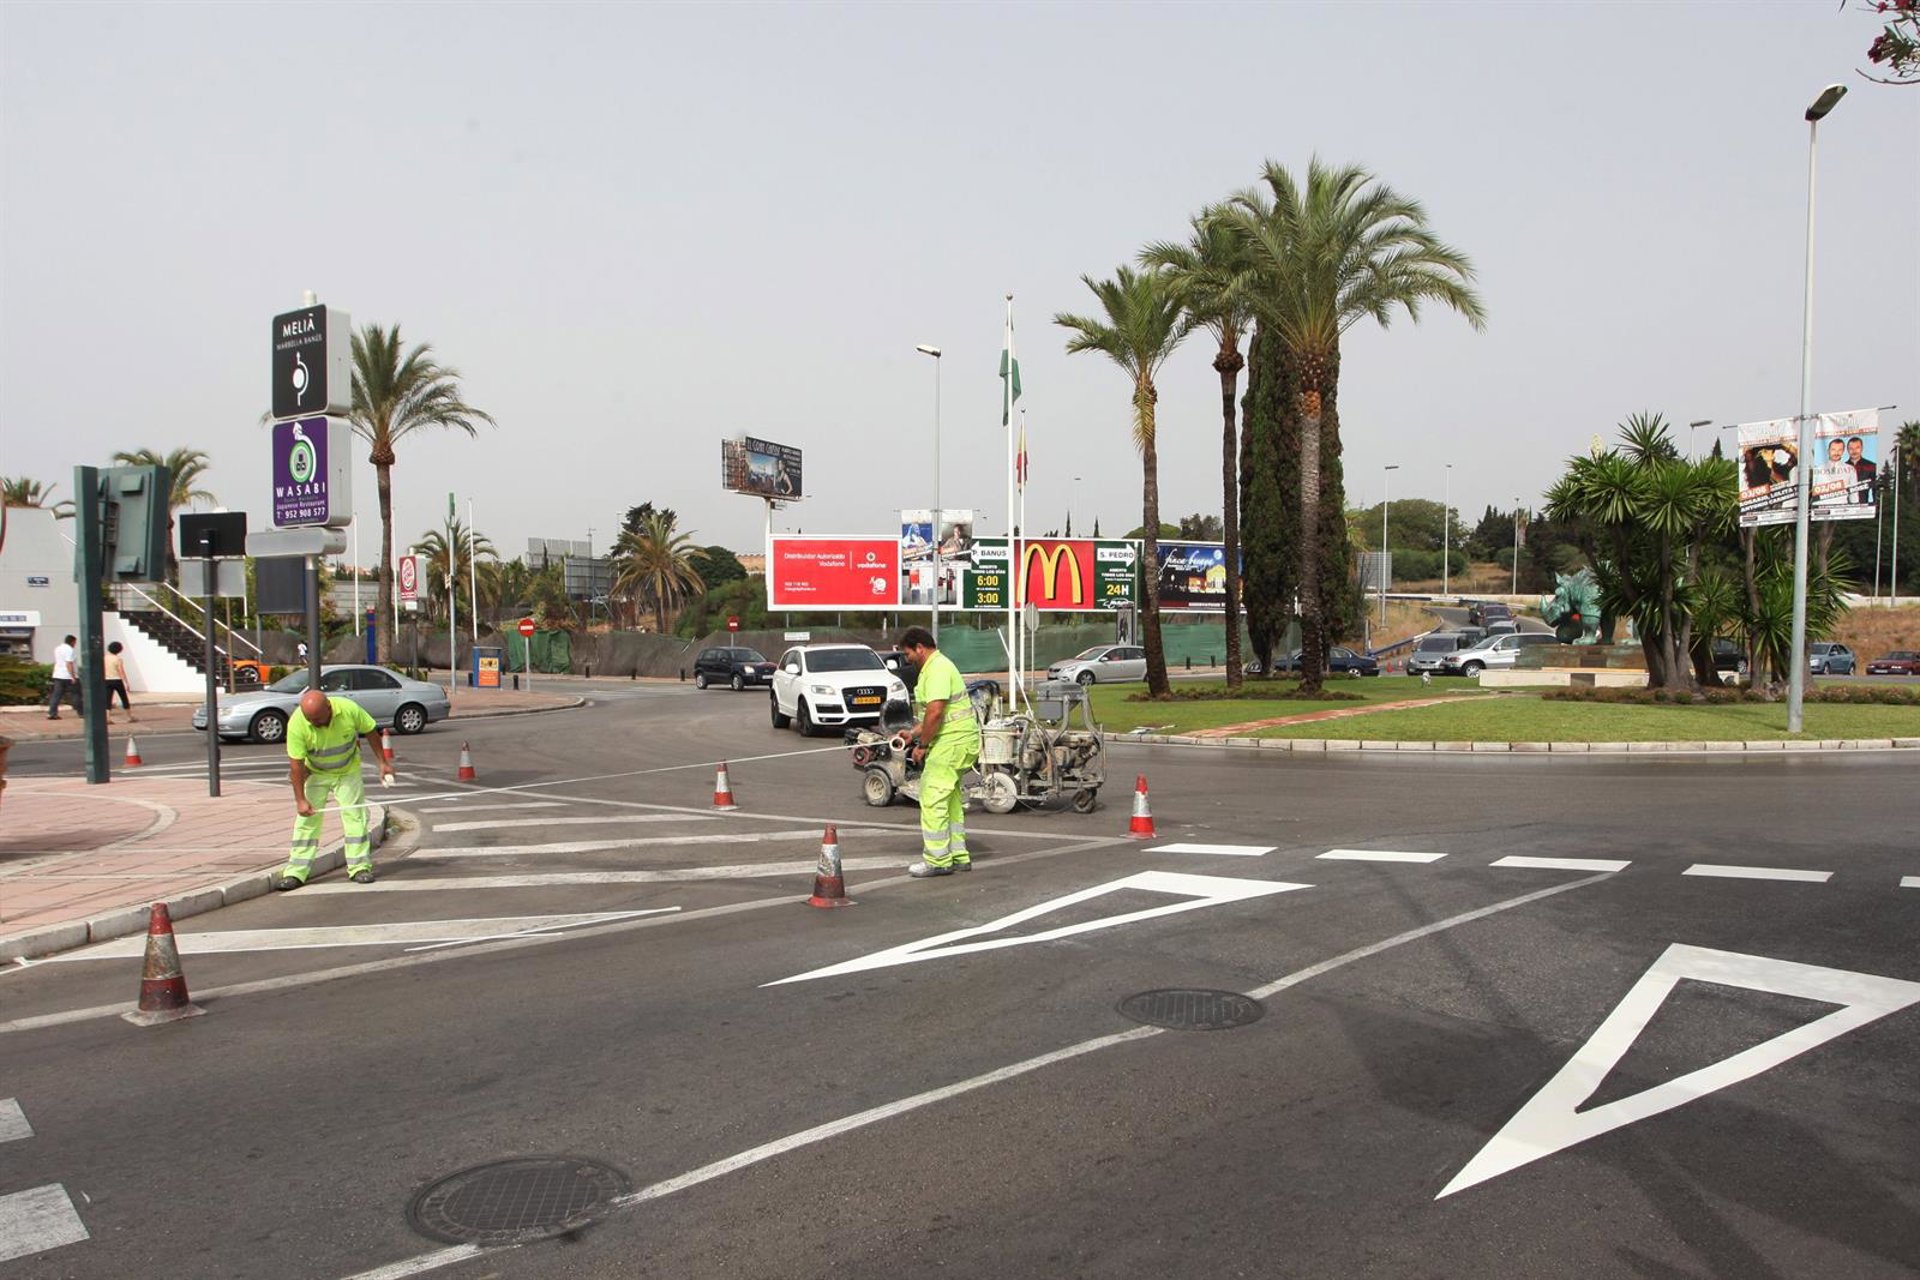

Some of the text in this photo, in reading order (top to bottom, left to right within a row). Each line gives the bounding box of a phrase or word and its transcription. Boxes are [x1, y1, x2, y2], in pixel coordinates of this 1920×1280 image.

[276, 481, 326, 498] WASABI
[285, 510, 297, 519] 952
[313, 506, 326, 516] 577
[1109, 551, 1134, 559] PEDRO
[977, 575, 999, 587] 6:00
[1106, 584, 1129, 595] 24H
[977, 592, 999, 604] 3:00
